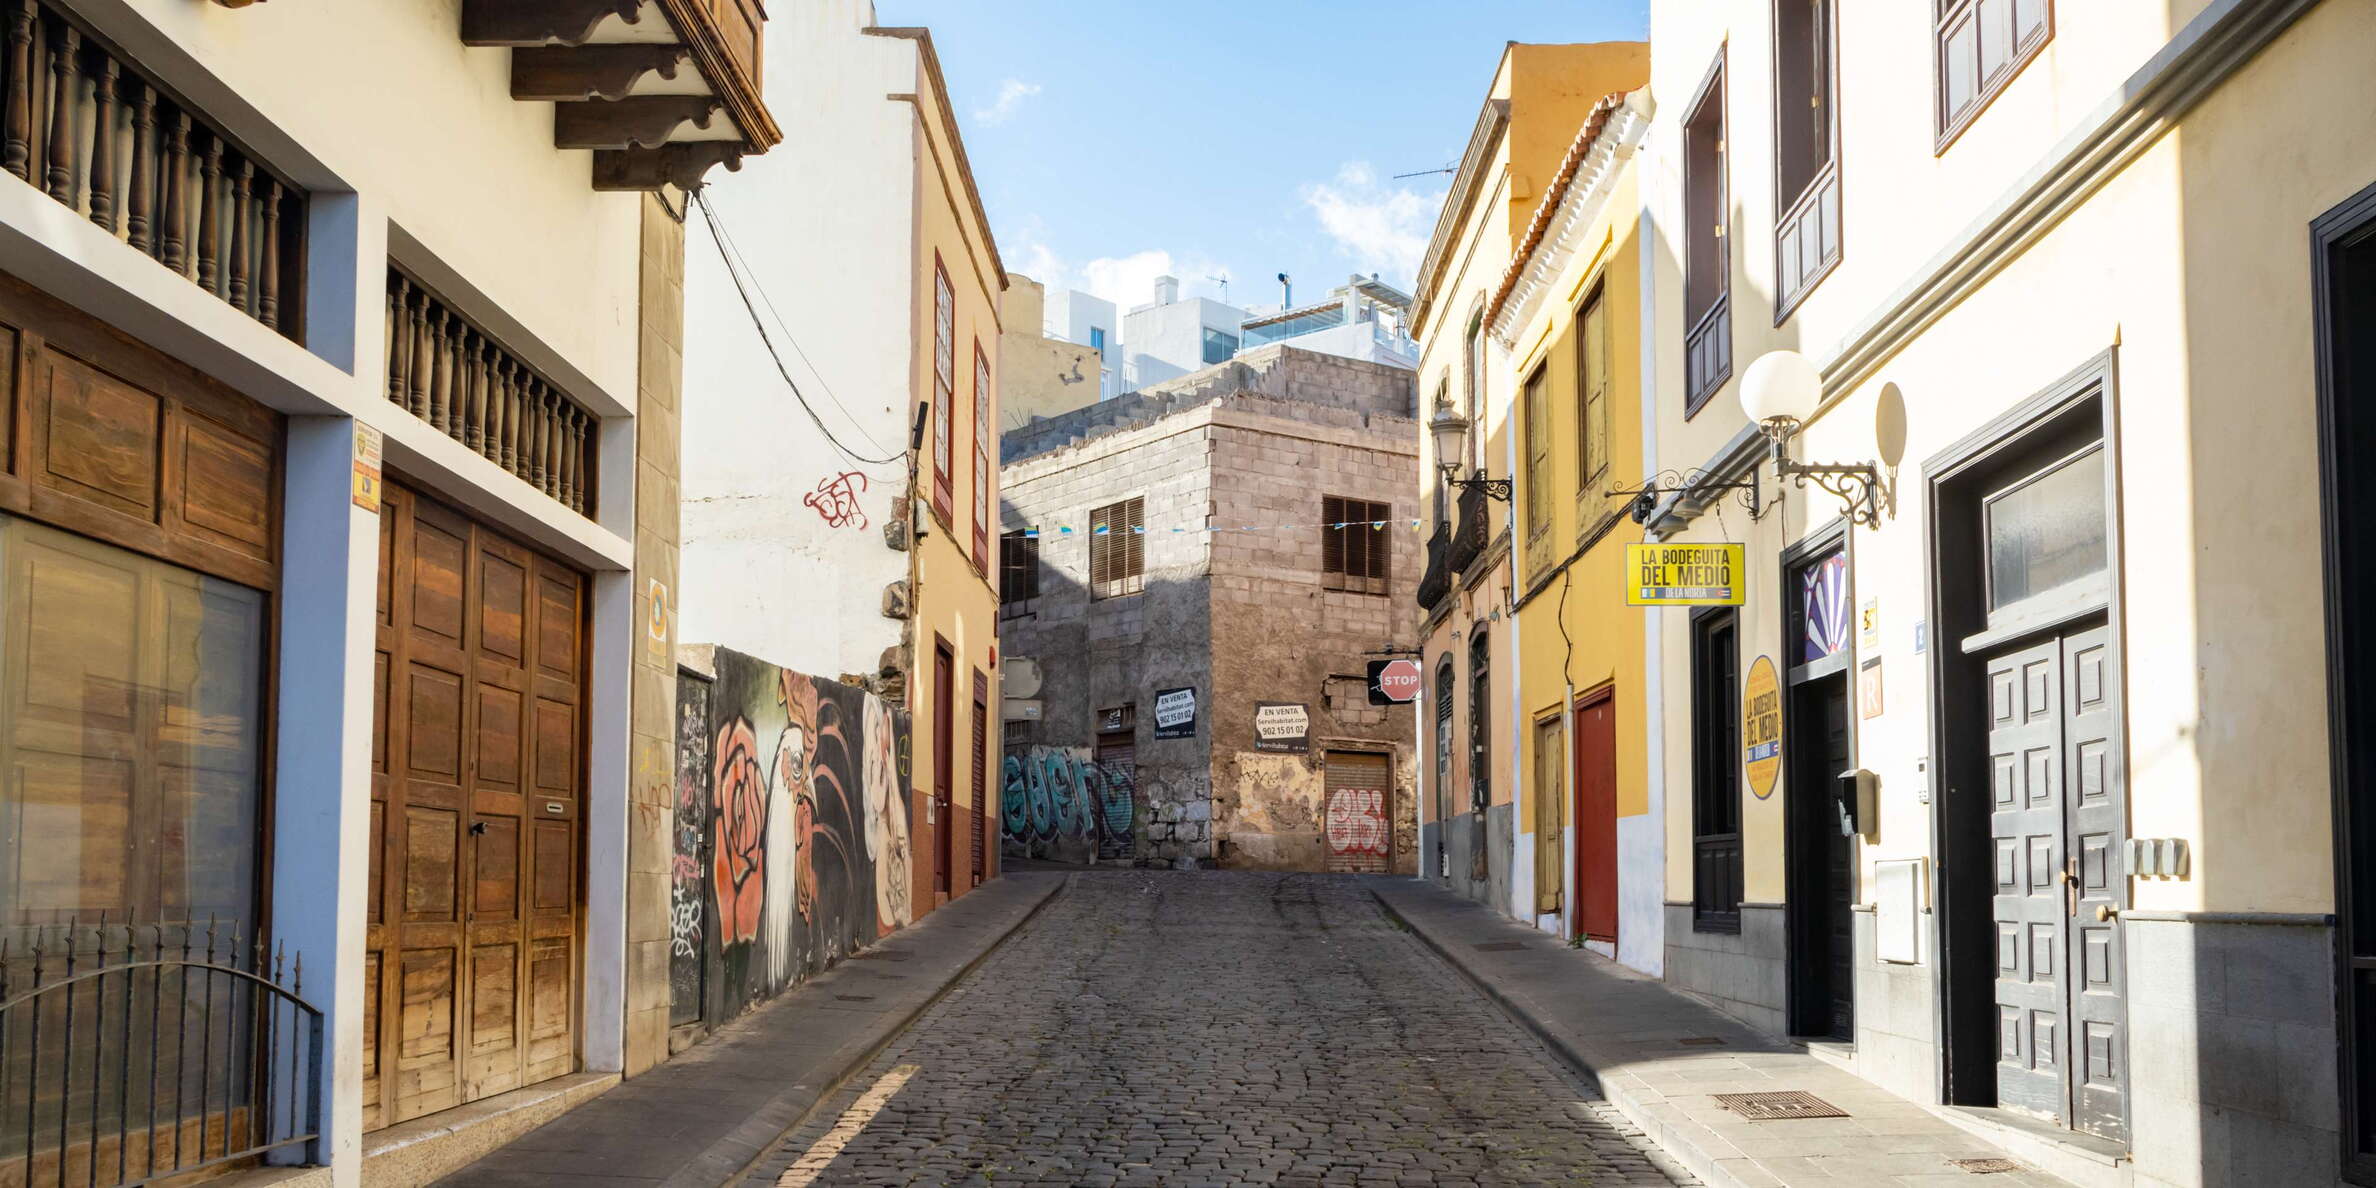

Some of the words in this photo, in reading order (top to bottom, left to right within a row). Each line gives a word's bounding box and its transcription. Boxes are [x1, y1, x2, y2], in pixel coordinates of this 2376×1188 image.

[1641, 549, 1657, 565] LA
[1662, 549, 1730, 565] BODEGUITA
[1641, 566, 1671, 586] DEL
[1677, 566, 1730, 586] MEDIO
[1665, 588, 1674, 598] DE
[1675, 588, 1684, 598] LA
[1384, 675, 1418, 686] STOP
[1170, 693, 1187, 702] VENTA
[1746, 698, 1753, 719] LA
[1753, 689, 1777, 717] BODEGUITA
[1171, 713, 1177, 722] 15
[1262, 727, 1276, 736] 902
[1278, 727, 1285, 735] 15
[1286, 726, 1294, 735] 01
[1295, 725, 1304, 734] 02
[1747, 719, 1758, 746] DEL
[1759, 711, 1779, 743] MEDIO
